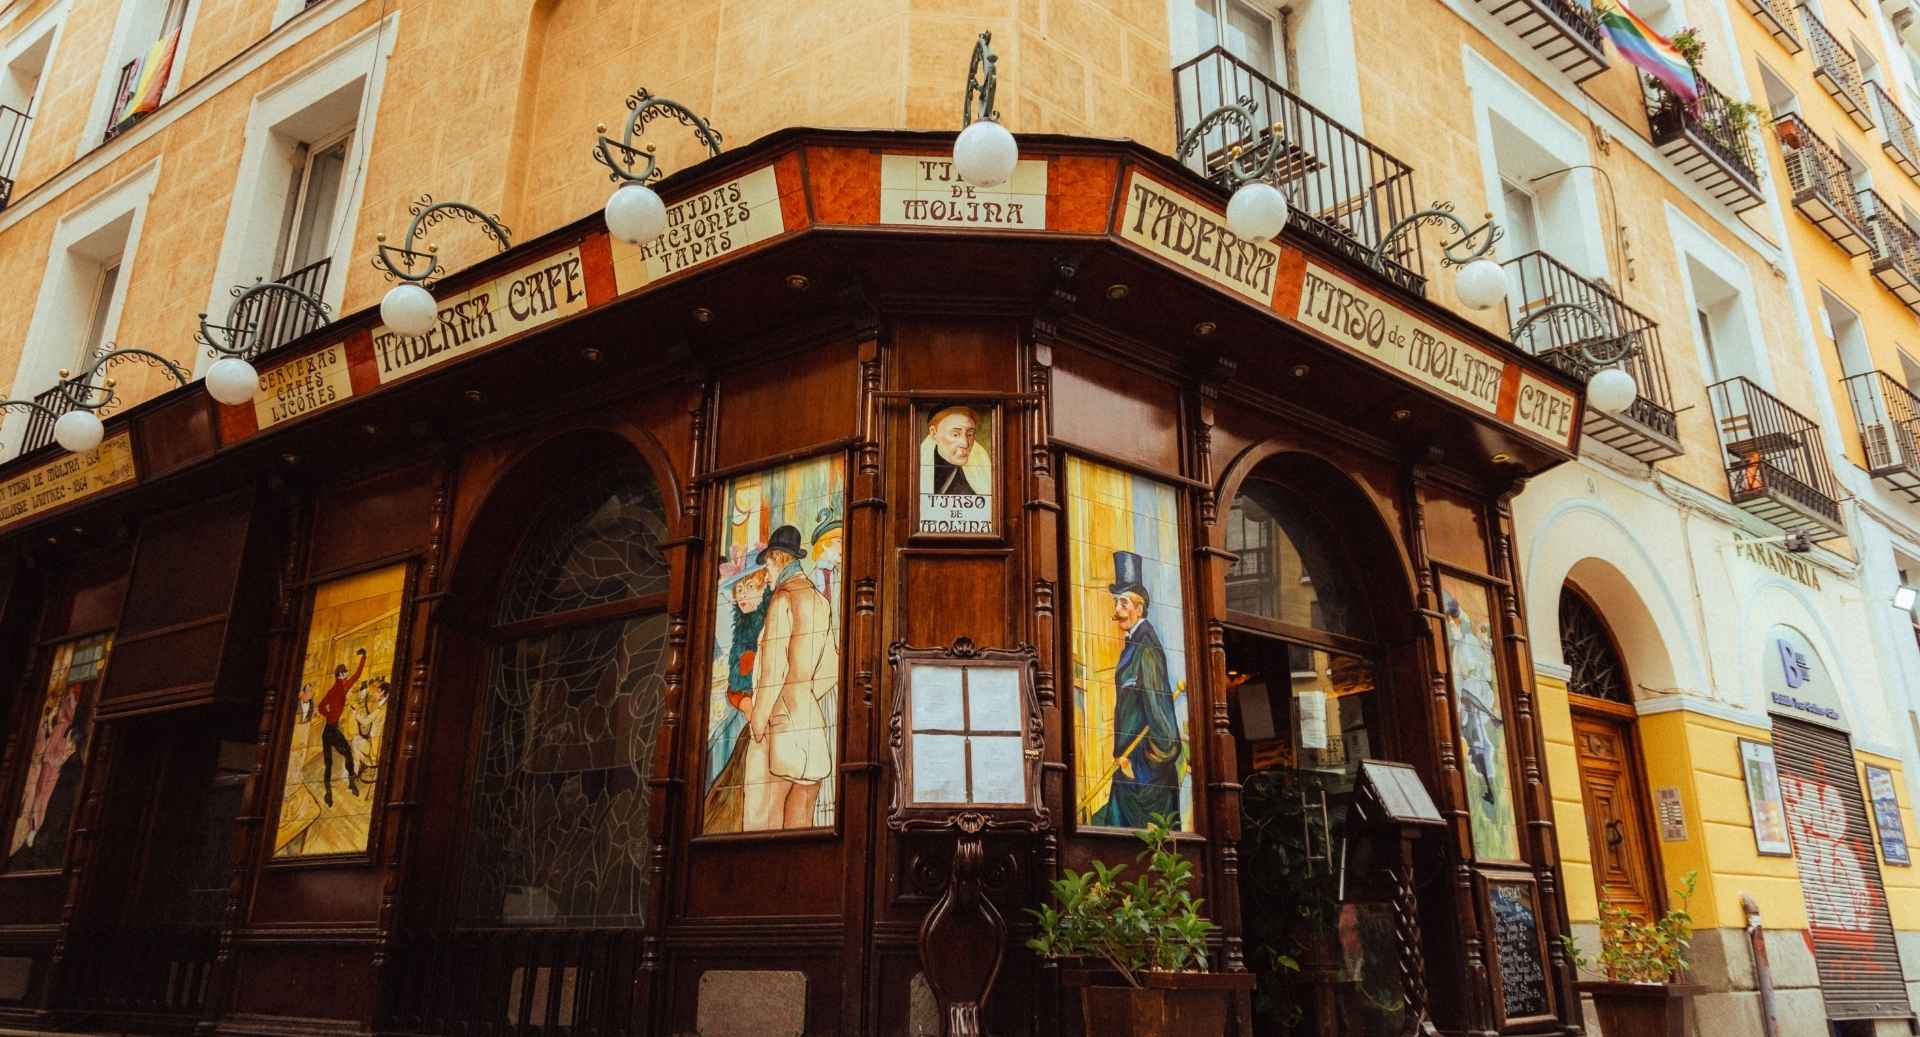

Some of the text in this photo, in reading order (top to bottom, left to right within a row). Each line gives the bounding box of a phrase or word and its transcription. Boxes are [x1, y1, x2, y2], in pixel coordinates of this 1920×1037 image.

[666, 182, 742, 228] MIDAS
[951, 185, 977, 199] DE
[902, 199, 1024, 224] MOLINA
[660, 231, 732, 273] TAPAS
[1132, 183, 1277, 297] TABERNA
[1304, 271, 1504, 405] TIRSO de MOLINA
[259, 348, 338, 391] CERVEZAS
[271, 385, 336, 421] LICORES
[928, 495, 986, 509] TIRSO
[950, 510, 963, 519] DE
[920, 520, 993, 533] MOLINA
